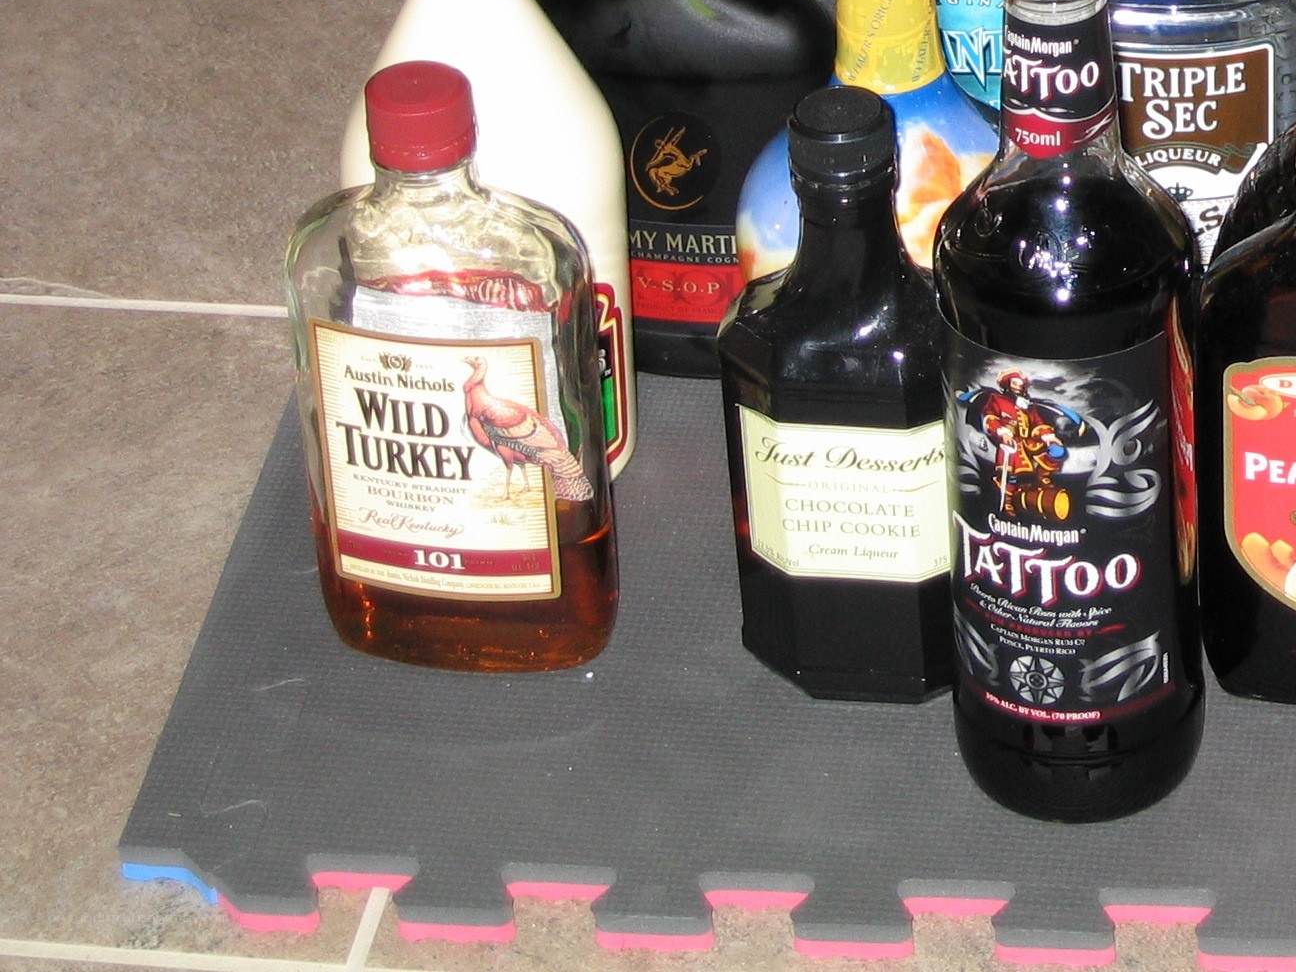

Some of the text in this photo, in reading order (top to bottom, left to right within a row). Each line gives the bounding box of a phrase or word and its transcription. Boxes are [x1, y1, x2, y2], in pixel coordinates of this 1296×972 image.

[1030, 36, 1074, 58] Morgan
[1003, 46, 1100, 102] ATTOO
[1119, 62, 1247, 102] TRIPLE
[1142, 98, 1219, 140] SEC
[1014, 127, 1061, 147] 750ml
[1134, 147, 1222, 167] LIQUEUR
[630, 229, 738, 255] MY MARTI
[707, 256, 739, 264] COGN
[343, 364, 455, 393] Austin Nichols
[353, 386, 450, 440] WILD
[335, 421, 476, 482] TURKEY
[755, 436, 945, 473] Just Desserts
[353, 474, 467, 495] KENTUCKY STRAIGHT
[367, 485, 454, 505] BOURBON
[386, 499, 437, 512] WHISKEY
[785, 498, 915, 518] CHOCOLATE
[782, 518, 921, 538] CHIP COOKIE
[988, 512, 1079, 547] Captain Morgan
[413, 549, 465, 570] 101
[808, 543, 848, 556] Cream
[854, 546, 898, 559] Liqueur
[952, 509, 1141, 607] TATTOO
